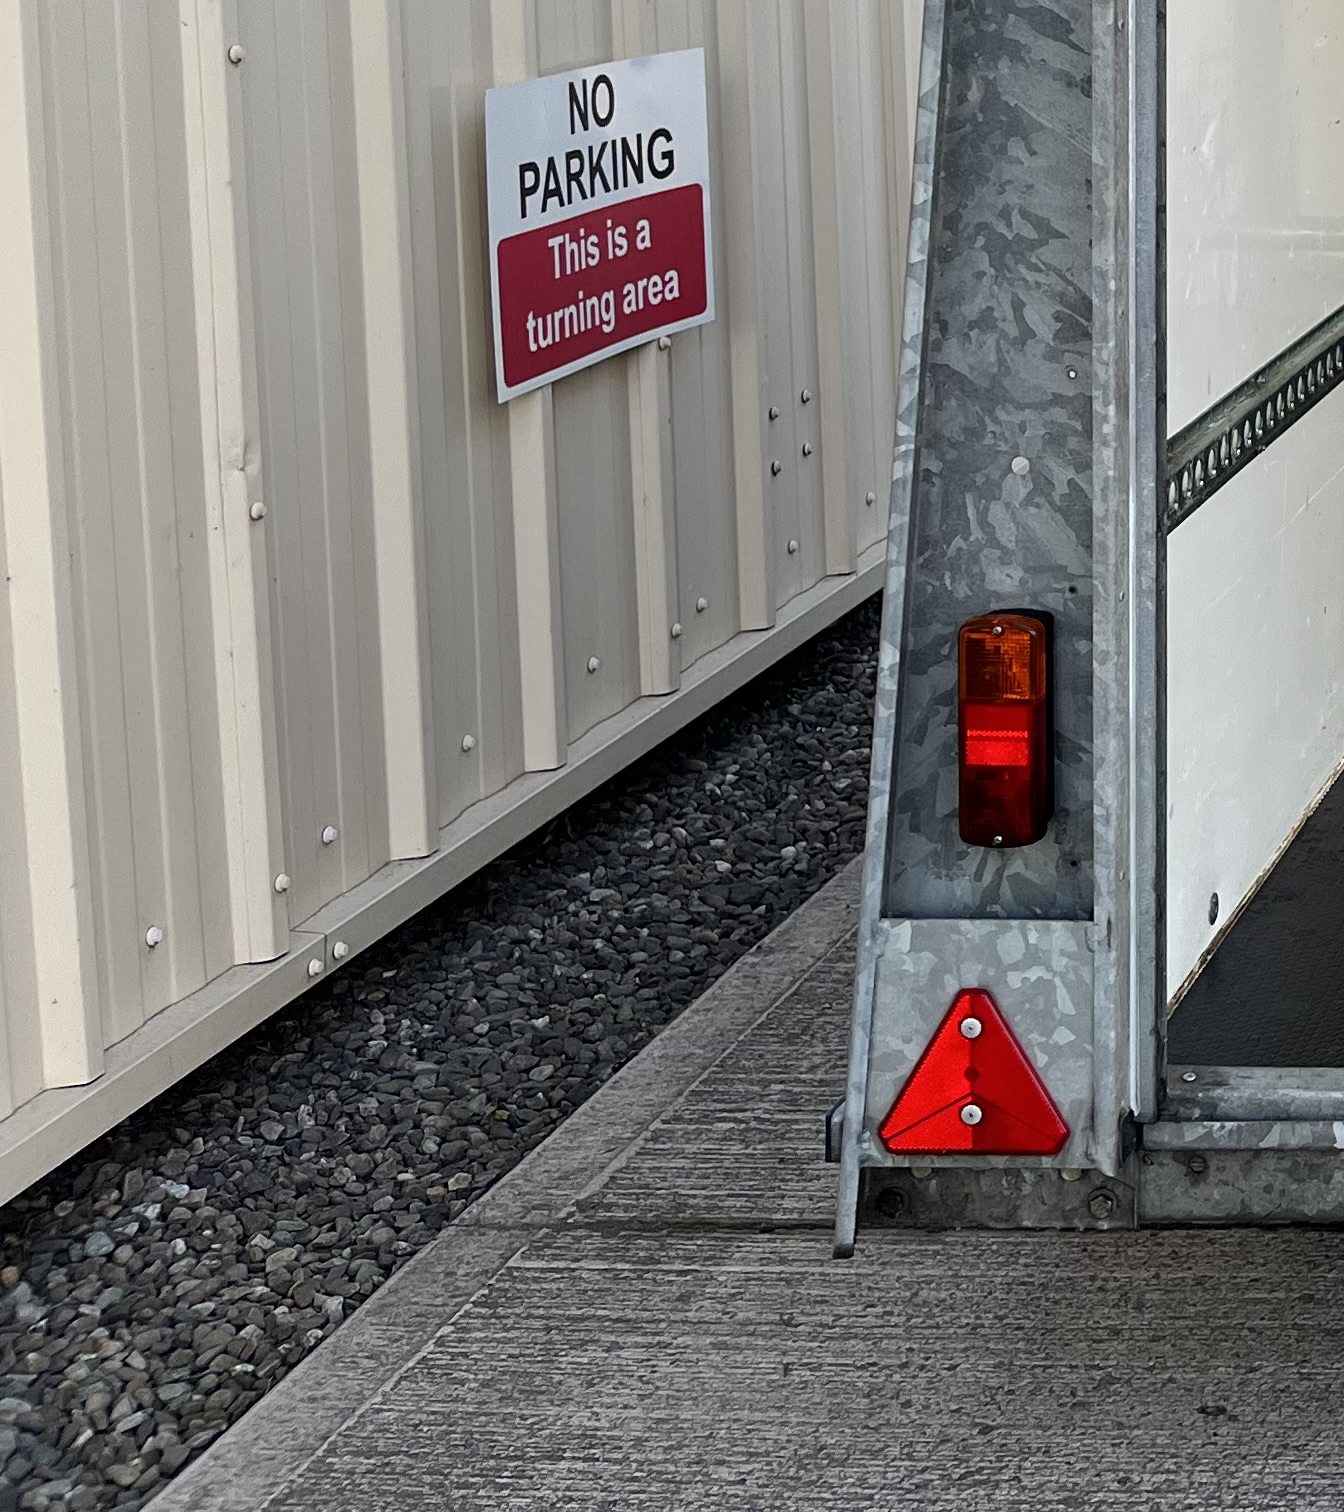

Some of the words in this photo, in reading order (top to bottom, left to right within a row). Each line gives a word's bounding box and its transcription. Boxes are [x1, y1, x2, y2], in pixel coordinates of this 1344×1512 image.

[567, 73, 615, 135] NO
[519, 127, 675, 219] PARKING
[547, 227, 600, 279] This
[606, 219, 628, 260] is
[635, 218, 651, 251] a
[526, 289, 615, 353] turning
[622, 268, 680, 315] area
